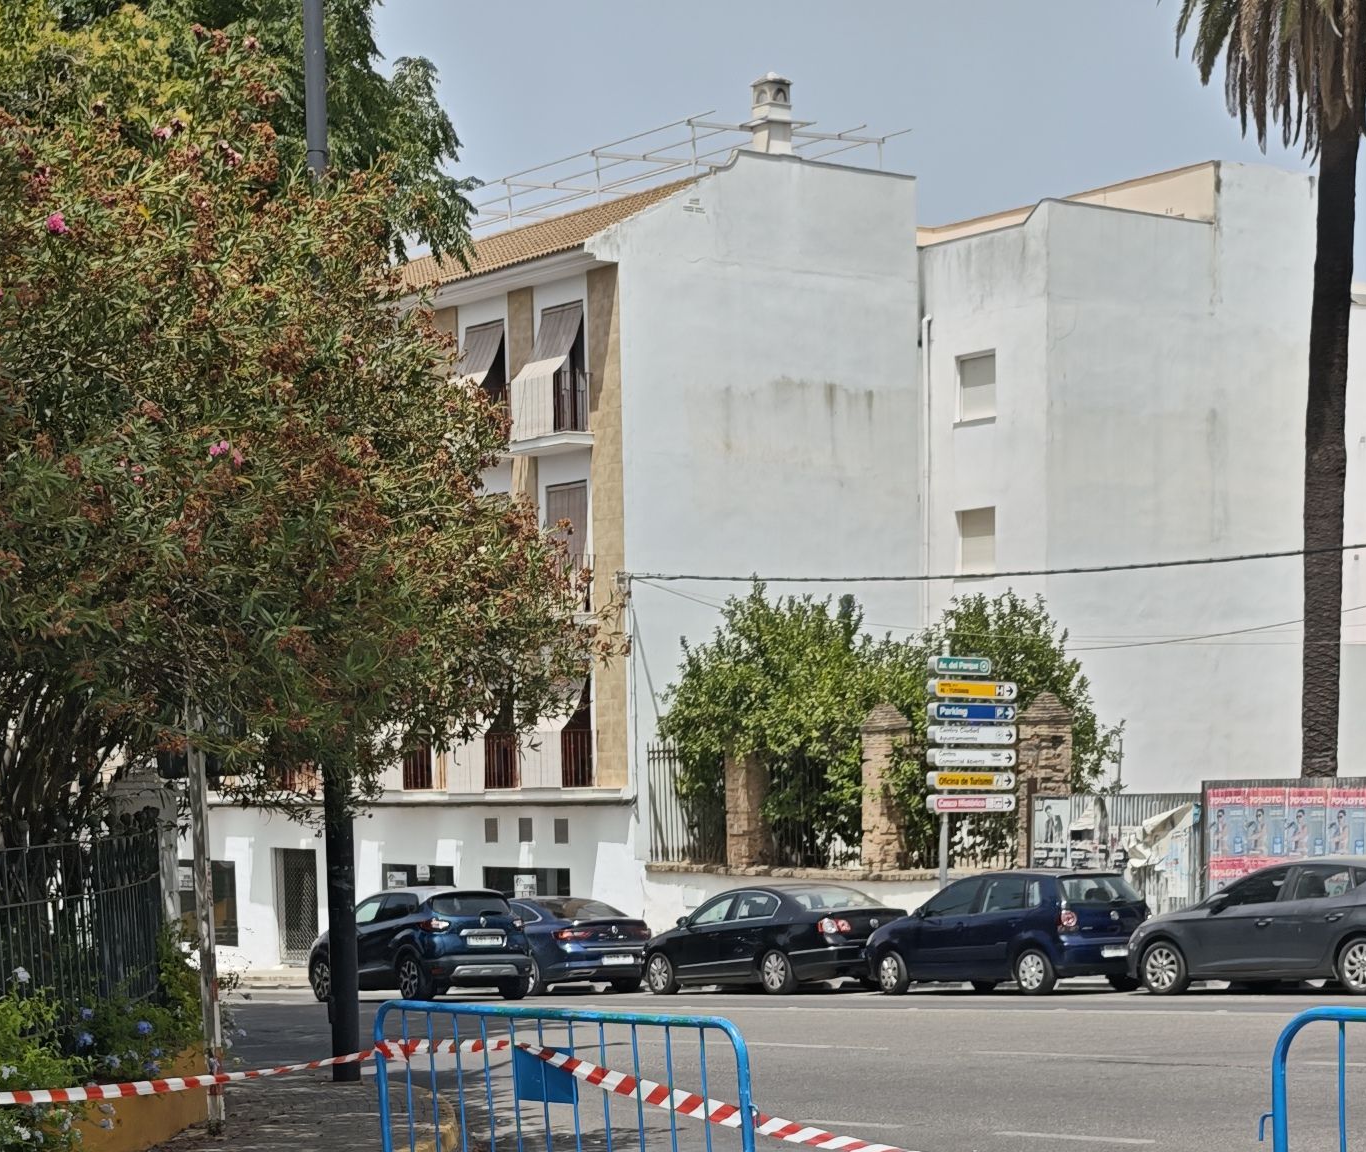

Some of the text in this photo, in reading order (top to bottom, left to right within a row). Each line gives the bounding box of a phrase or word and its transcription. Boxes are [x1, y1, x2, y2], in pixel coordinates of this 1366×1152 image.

[948, 661, 958, 669] del
[939, 706, 969, 718] Parking
[938, 776, 993, 786] Oficina de Turismo
